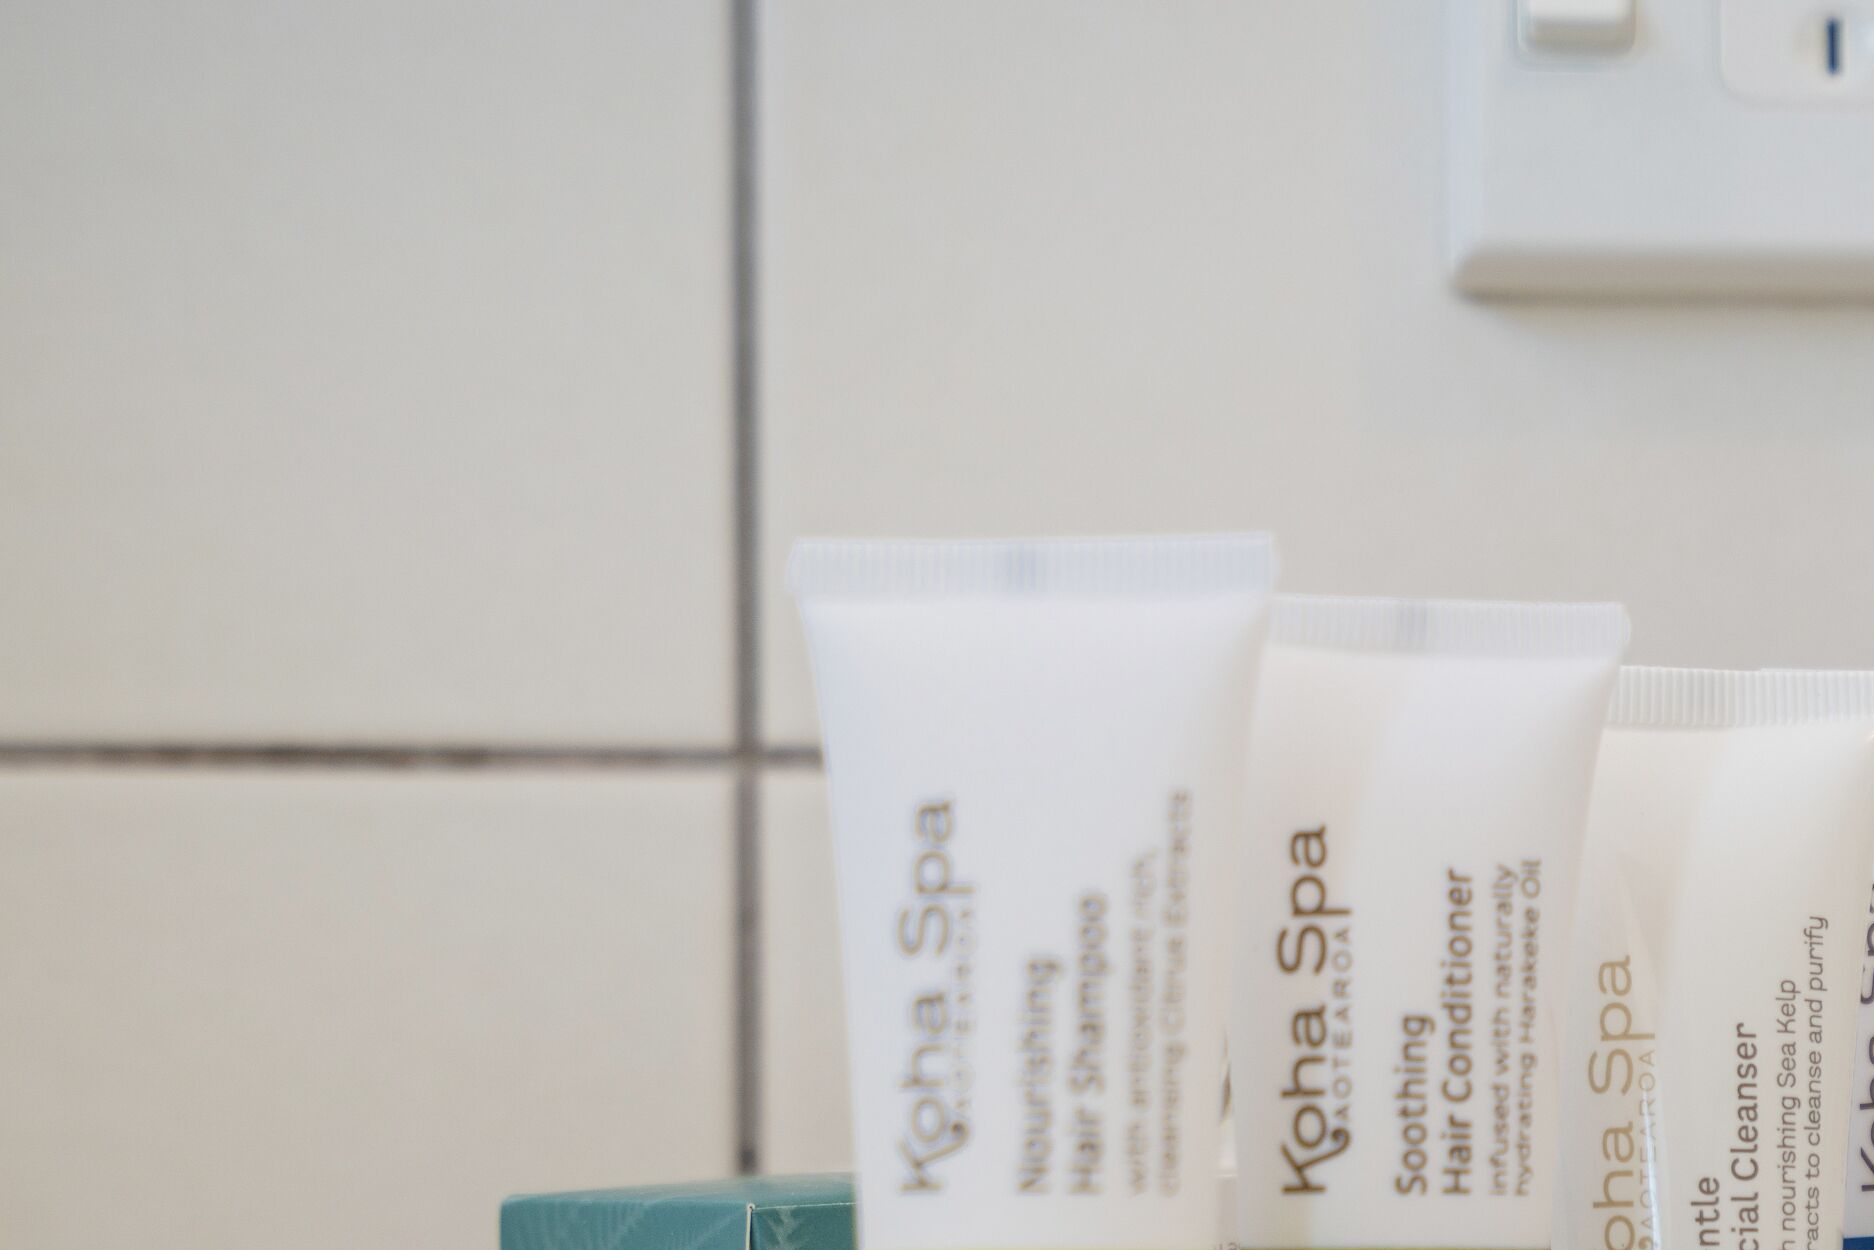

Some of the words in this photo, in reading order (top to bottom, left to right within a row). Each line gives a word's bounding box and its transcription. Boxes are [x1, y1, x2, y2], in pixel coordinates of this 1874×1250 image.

[896, 800, 976, 958] Spa
[1276, 824, 1353, 977] Spa
[1493, 863, 1519, 999] naturally
[1521, 859, 1542, 900] Oil
[1069, 893, 1110, 1097] Shampoo
[1440, 867, 1473, 1103] Conditioner
[1519, 905, 1540, 1044] Harakeke
[1776, 979, 1802, 1035] Kelp
[1804, 915, 1829, 993] purify
[1804, 998, 1824, 1045] and
[896, 991, 970, 1196] Koha
[1016, 957, 1061, 1197] Nourishing
[1331, 927, 1353, 1135] AOTEAROA
[1492, 1006, 1512, 1076] with
[1588, 954, 1656, 1096] Spa
[1777, 1043, 1798, 1089] Sea
[1068, 1106, 1102, 1197] Hair
[1281, 1004, 1352, 1197] Koha
[1394, 1013, 1435, 1196] Soothing
[1440, 1113, 1473, 1196] Hair
[1490, 1083, 1510, 1196] infused
[1515, 1052, 1538, 1197] hydrating
[1731, 1023, 1760, 1183] Cleanser
[1776, 1096, 1801, 1232] nourishing
[1803, 1053, 1823, 1147] cleanse
[1805, 1152, 1821, 1182] to
